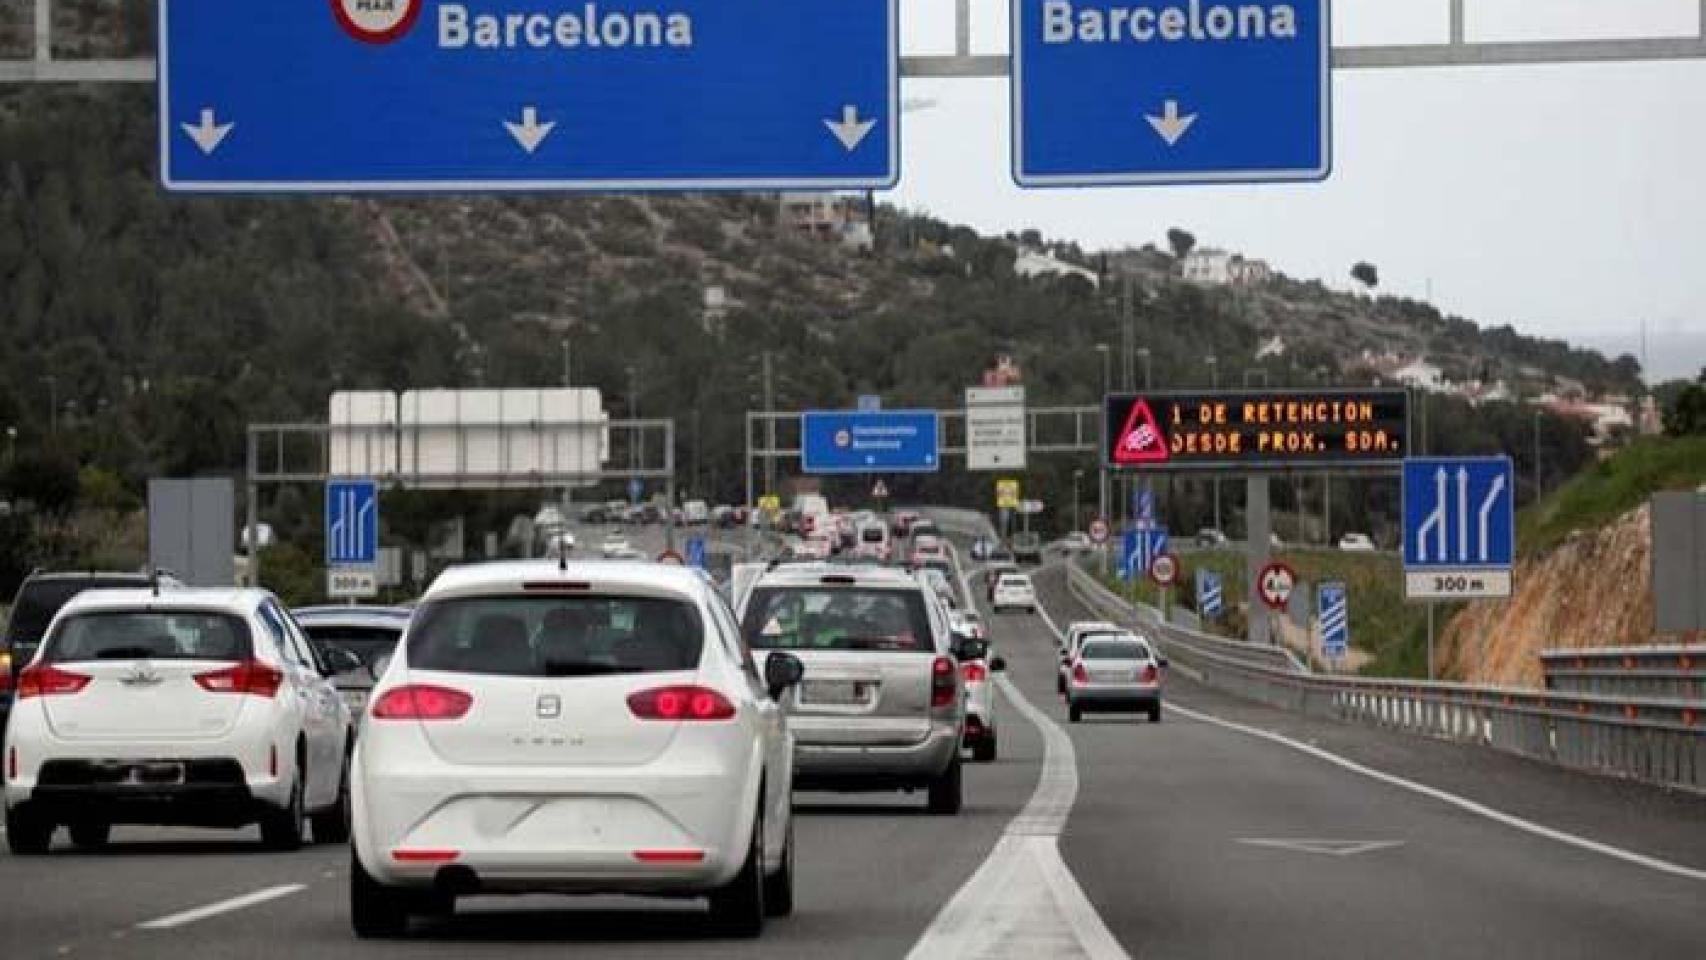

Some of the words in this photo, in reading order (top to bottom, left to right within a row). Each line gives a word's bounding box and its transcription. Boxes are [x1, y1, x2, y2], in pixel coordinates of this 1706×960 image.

[437, 2, 693, 48] Barcelona
[1042, 0, 1297, 43] Barcelona
[1200, 402, 1226, 424] DE
[1243, 402, 1373, 423] RETENCION
[1258, 431, 1327, 453] PROX.
[1434, 576, 1468, 592] 300
[1471, 579, 1485, 591] m
